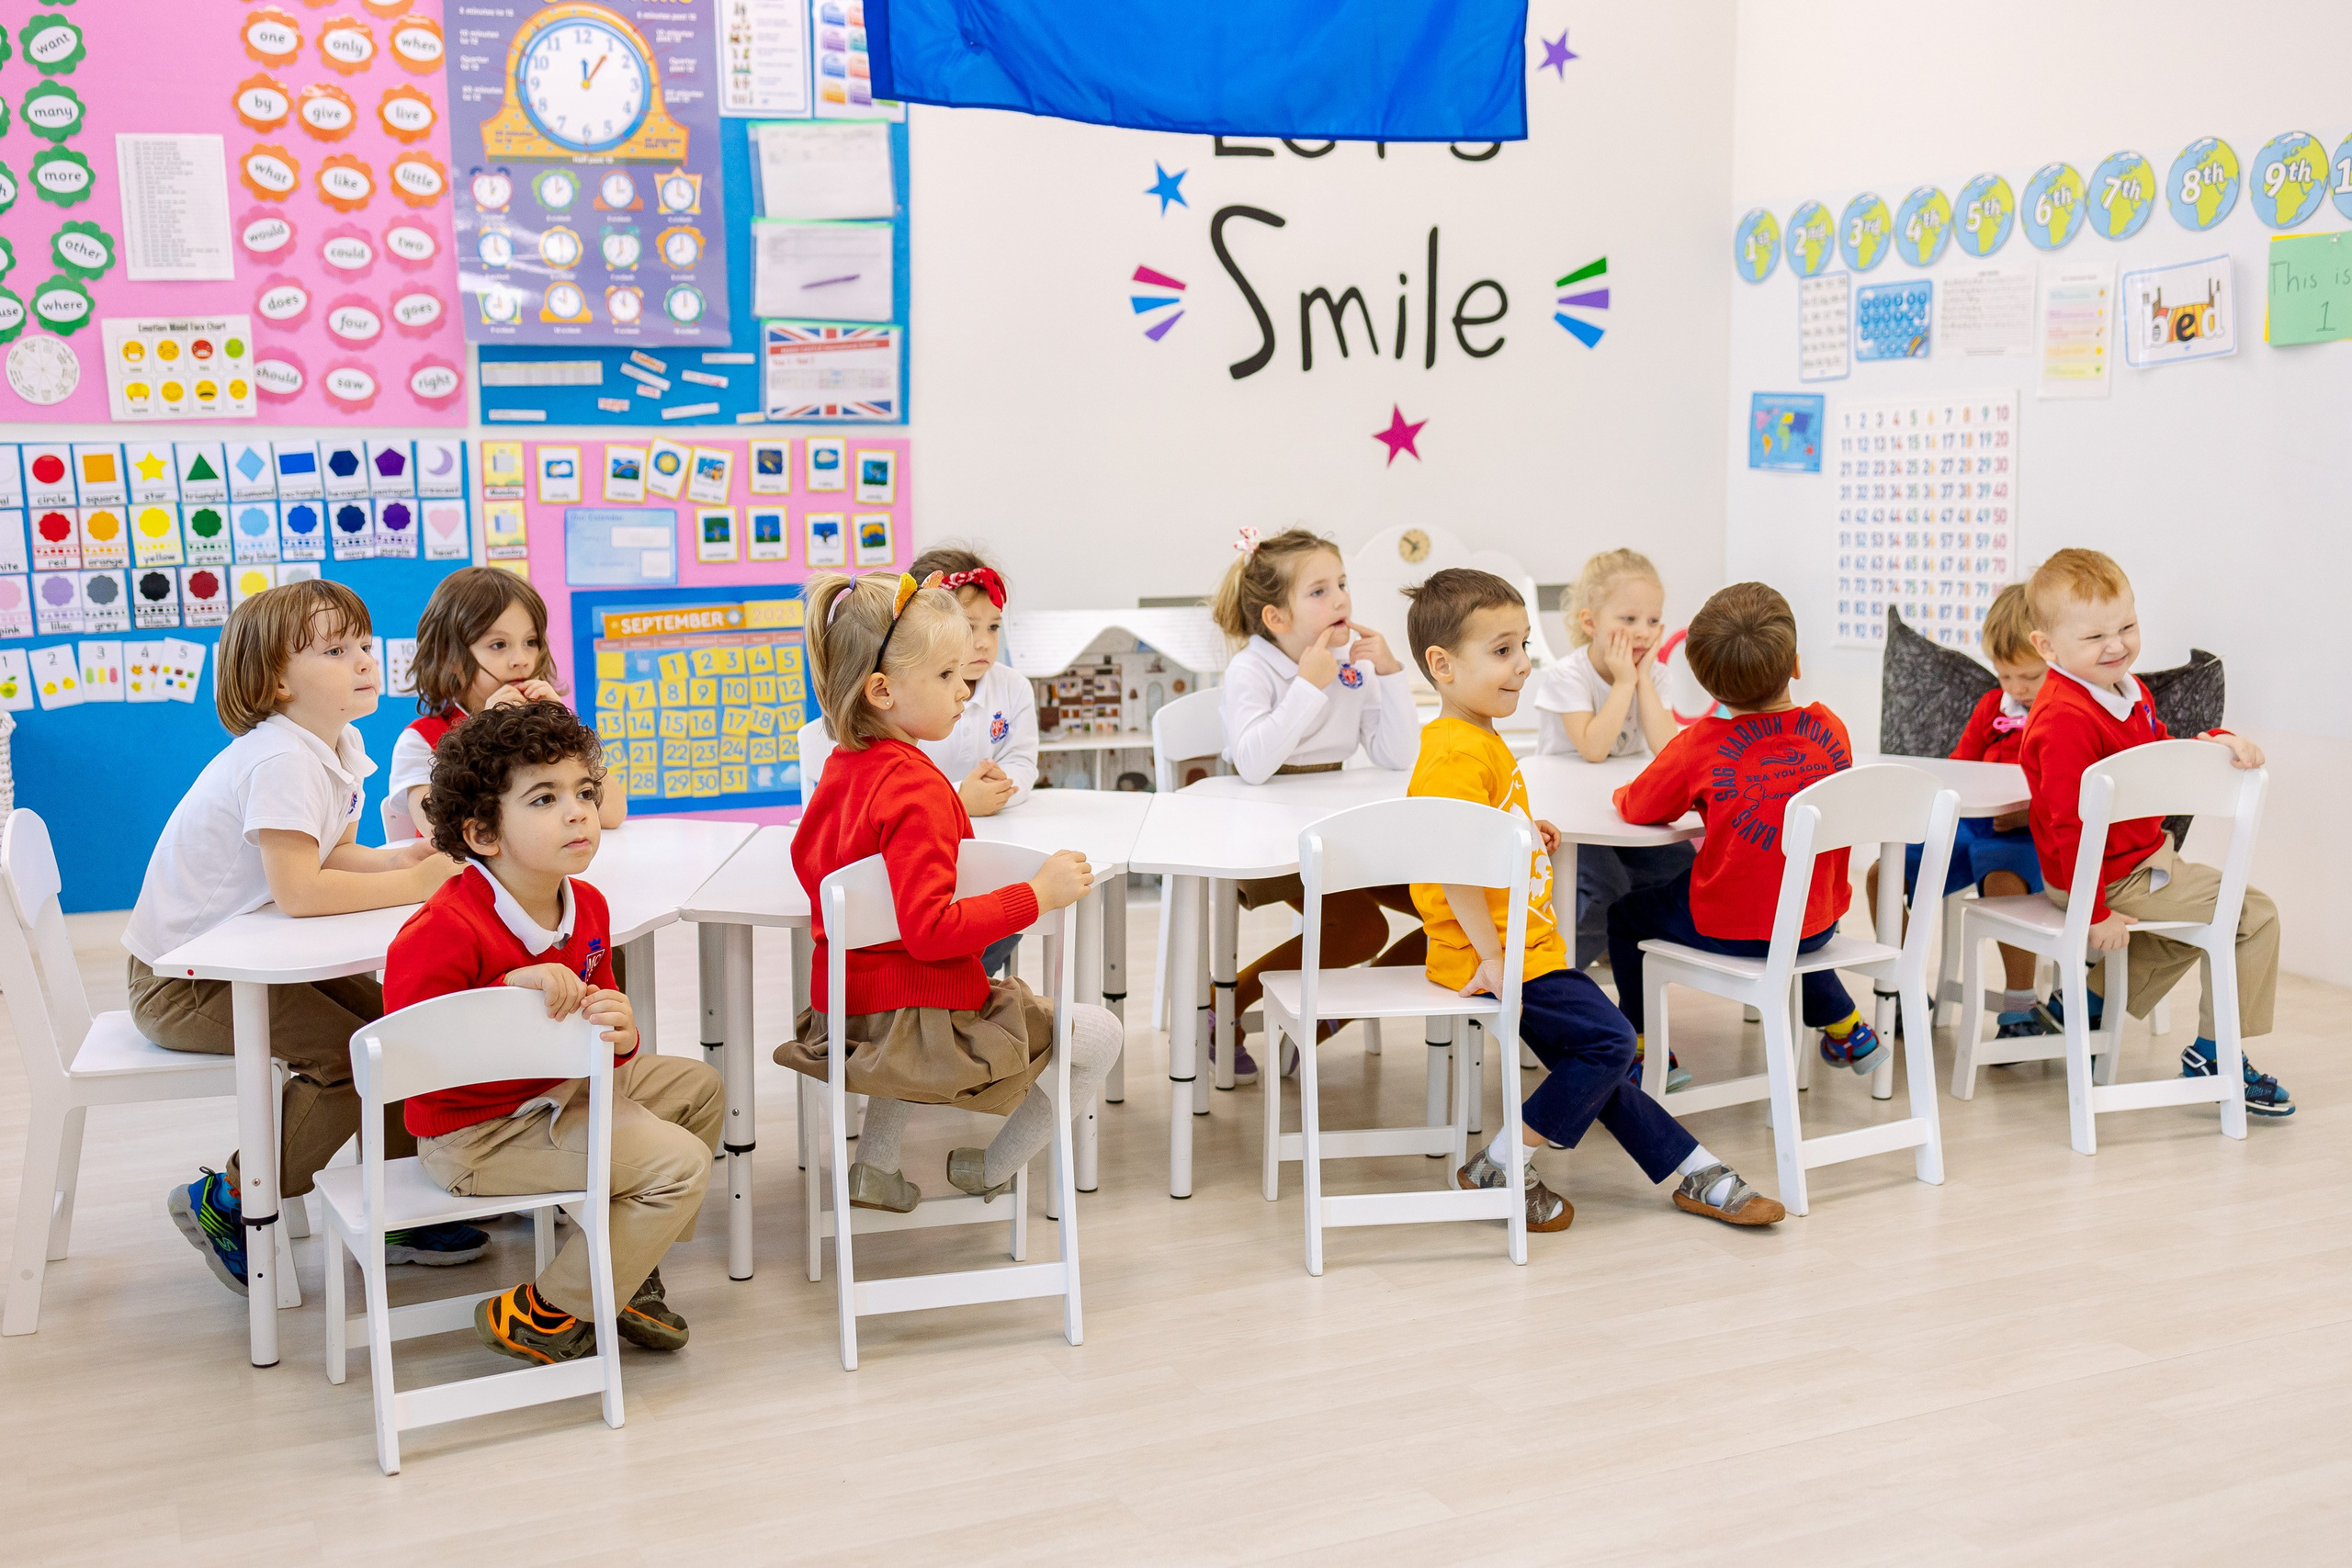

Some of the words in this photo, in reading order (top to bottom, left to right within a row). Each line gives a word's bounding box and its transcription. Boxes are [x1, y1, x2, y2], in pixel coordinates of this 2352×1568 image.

[37, 33, 70, 54] want
[260, 32, 285, 43] one
[575, 30, 592, 43] 12
[333, 39, 363, 57] only
[401, 38, 436, 51] when
[547, 37, 560, 51] 11
[606, 39, 614, 51] 1
[534, 57, 548, 70] 10
[622, 55, 629, 68] 2
[531, 77, 539, 90] 9
[630, 78, 639, 92] 3
[254, 96, 272, 113] by
[538, 98, 548, 112] 8
[623, 101, 631, 114] 4
[35, 106, 73, 119] many
[312, 107, 340, 120] give
[396, 107, 419, 119] live
[558, 116, 567, 131] 7
[605, 120, 612, 135] 5
[582, 124, 591, 139] 6
[45, 171, 82, 181] more
[254, 160, 287, 184] what
[402, 169, 433, 186] little
[2264, 159, 2312, 198] 9th
[334, 174, 357, 188] like
[2180, 163, 2224, 204] 8th
[2101, 175, 2141, 210] 7th
[2034, 183, 2072, 226] 6th
[1965, 197, 2000, 233] 5th
[1905, 204, 1940, 243] 4th
[248, 224, 285, 243] would
[1848, 217, 1881, 247] 3rd
[398, 237, 424, 250] two
[1746, 229, 1770, 262] 1st
[1793, 223, 1826, 256] 2nd
[65, 239, 102, 259] other
[331, 248, 365, 260] could
[2270, 260, 2318, 296] This
[2335, 265, 2351, 287] is
[1211, 205, 1508, 379] Smile
[42, 300, 83, 310] where
[268, 296, 299, 310] does
[401, 303, 433, 320] goes
[2316, 301, 2336, 333] 1
[339, 316, 368, 332] four
[2143, 291, 2225, 349] bed
[256, 367, 298, 385] should
[418, 375, 450, 391] right
[337, 379, 364, 389] saw
[1860, 412, 1867, 429] 2
[1945, 407, 1952, 424] 7
[85, 494, 119, 504] square
[144, 491, 165, 501] star
[185, 491, 224, 502] triangle
[233, 488, 276, 499] diamond
[372, 488, 411, 497] pentagon
[38, 495, 66, 505] circle
[144, 553, 175, 563] yellow
[258, 551, 277, 560] blue
[293, 549, 314, 558] blue
[379, 547, 411, 557] purple
[432, 547, 459, 557] heart
[48, 558, 66, 567] red
[89, 558, 123, 569] orange
[195, 555, 224, 565] green
[51, 621, 73, 630] lilac
[95, 622, 118, 632] grey
[621, 611, 724, 634] SEPTEMBER
[752, 607, 797, 621] 2023
[48, 652, 57, 666] 2
[97, 646, 105, 659] 3
[141, 646, 149, 659] 4
[179, 646, 187, 659] 5
[3, 656, 8, 668] 1
[670, 659, 678, 675] 1
[703, 653, 714, 669] 2
[726, 652, 738, 668] 3
[754, 651, 766, 666] 4
[784, 651, 795, 668] 5
[605, 688, 617, 704] 6
[635, 687, 645, 703] 7
[667, 685, 680, 701] 8
[697, 684, 709, 701] 9
[725, 683, 745, 699] 10
[755, 682, 771, 697] 11
[784, 680, 801, 695] 12
[602, 716, 621, 733] 13
[630, 715, 650, 731] 14
[665, 716, 684, 732] 15
[693, 714, 712, 730] 16
[729, 713, 747, 729] 17
[753, 710, 771, 728] 18
[782, 709, 800, 725] 19
[634, 747, 653, 761] 21
[666, 744, 688, 760] 22
[695, 746, 716, 761] 23
[723, 741, 743, 756] 24
[753, 743, 775, 758] 25
[1712, 767, 1738, 802] SAG
[1794, 711, 1852, 770] MONTAU
[1774, 769, 1795, 778] YOU
[1800, 764, 1827, 773] SOON
[633, 773, 654, 789] 28
[668, 776, 689, 791] 29
[695, 775, 717, 790] 30
[724, 771, 743, 786] 31
[1732, 810, 1778, 852] BAYS
